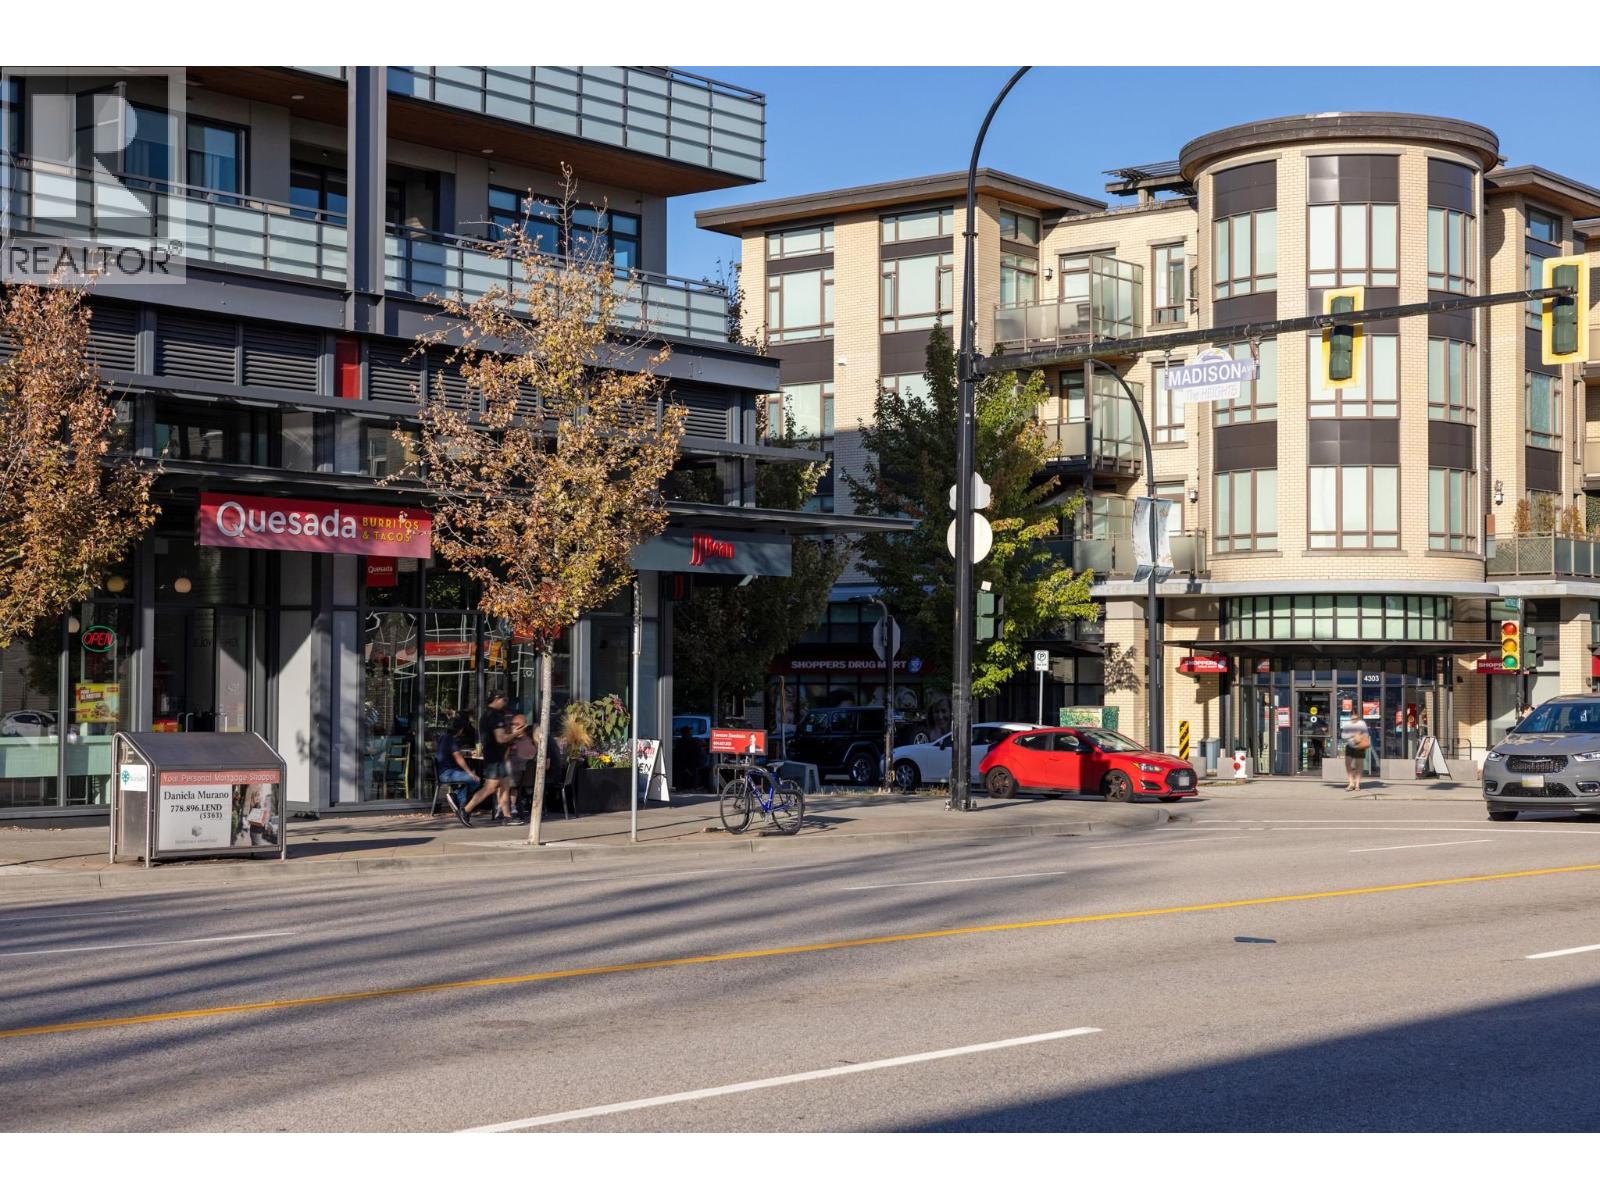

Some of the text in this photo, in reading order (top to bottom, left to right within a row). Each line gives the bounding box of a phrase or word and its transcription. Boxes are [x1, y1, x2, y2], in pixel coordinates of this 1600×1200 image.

[1168, 363, 1241, 387] MADISON
[216, 501, 357, 538] Quesada
[362, 516, 419, 530] BURRITOS
[362, 530, 412, 543] & TACOS
[83, 632, 113, 647] OPEN
[791, 660, 907, 669] SHOPPERS DRUG MRT
[164, 790, 230, 800] Daniela Murano
[170, 803, 223, 812] 778.896.LEND
